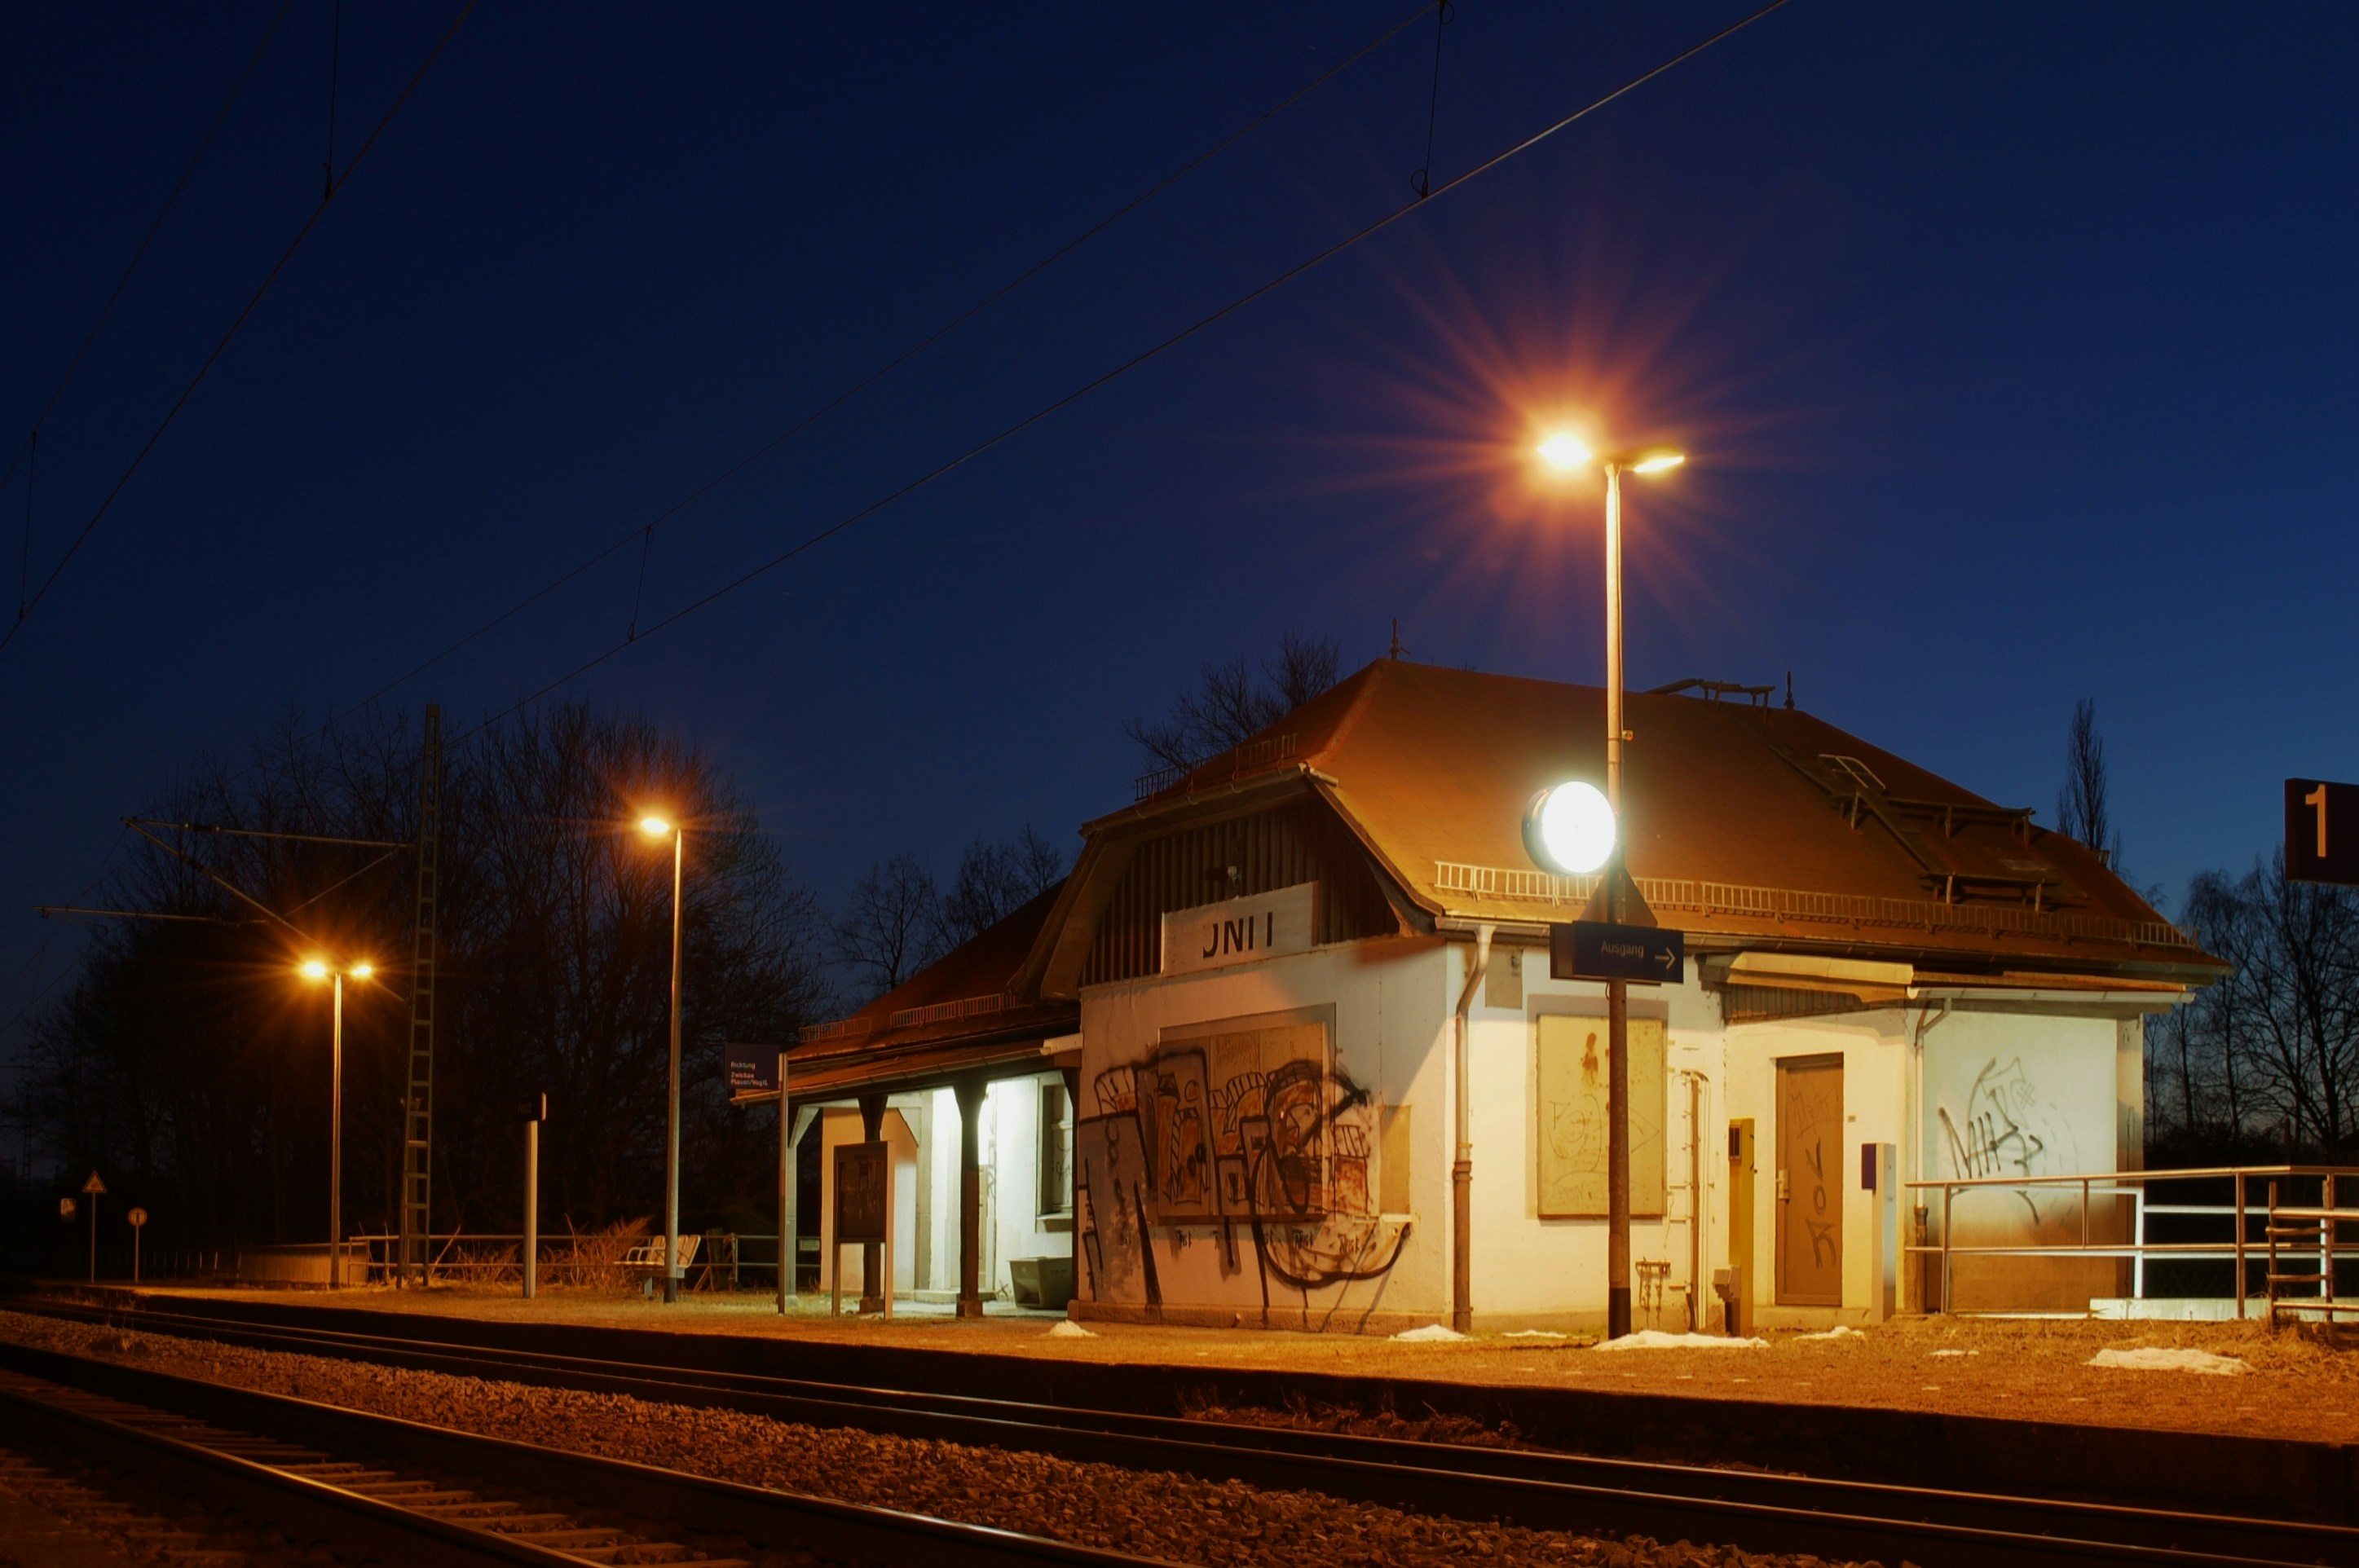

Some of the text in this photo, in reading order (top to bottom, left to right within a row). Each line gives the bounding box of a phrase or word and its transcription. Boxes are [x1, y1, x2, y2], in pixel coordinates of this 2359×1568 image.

[2304, 783, 2326, 858] 1
[1601, 940, 1644, 958] Ausgang
[731, 1061, 756, 1070] Richtung
